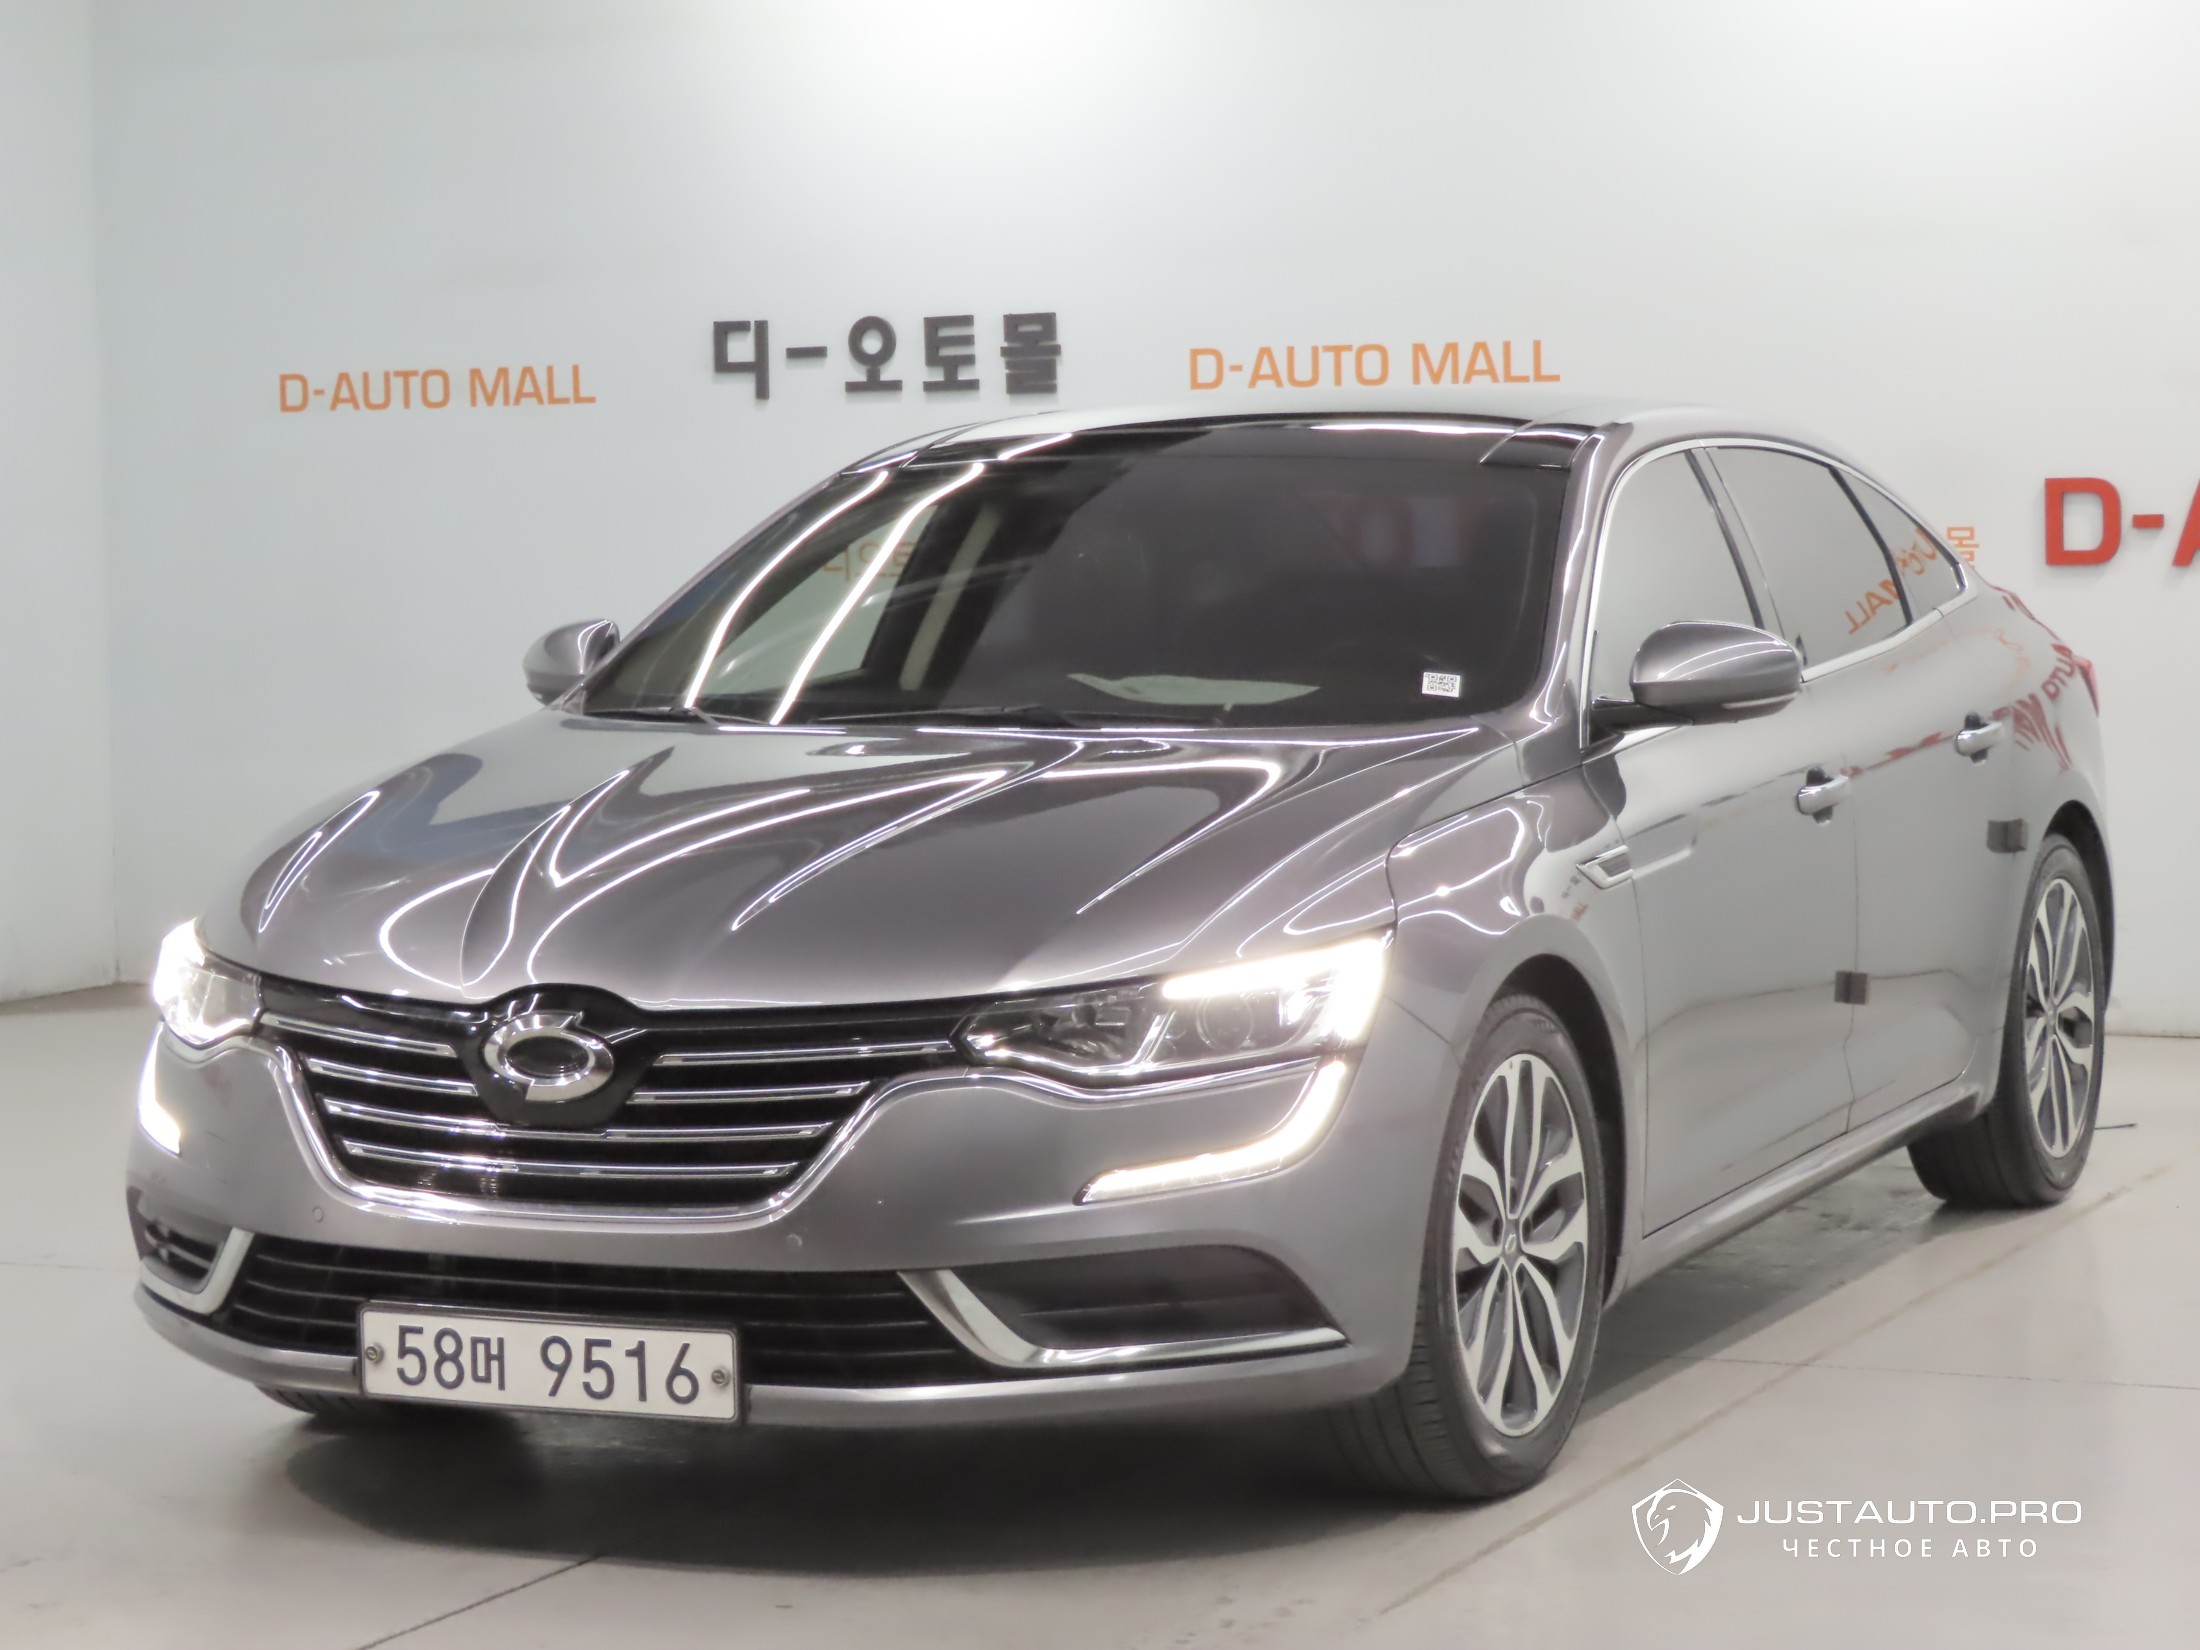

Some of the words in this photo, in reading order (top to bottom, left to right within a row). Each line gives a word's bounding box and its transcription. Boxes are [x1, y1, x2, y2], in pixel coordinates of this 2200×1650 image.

[279, 368, 451, 414] D-AUTO
[469, 364, 597, 407] MALL
[1189, 343, 1390, 391] D-AUTO
[1411, 339, 1561, 385] MALL
[396, 1325, 506, 1391] 58머
[540, 1335, 700, 1405] 9516
